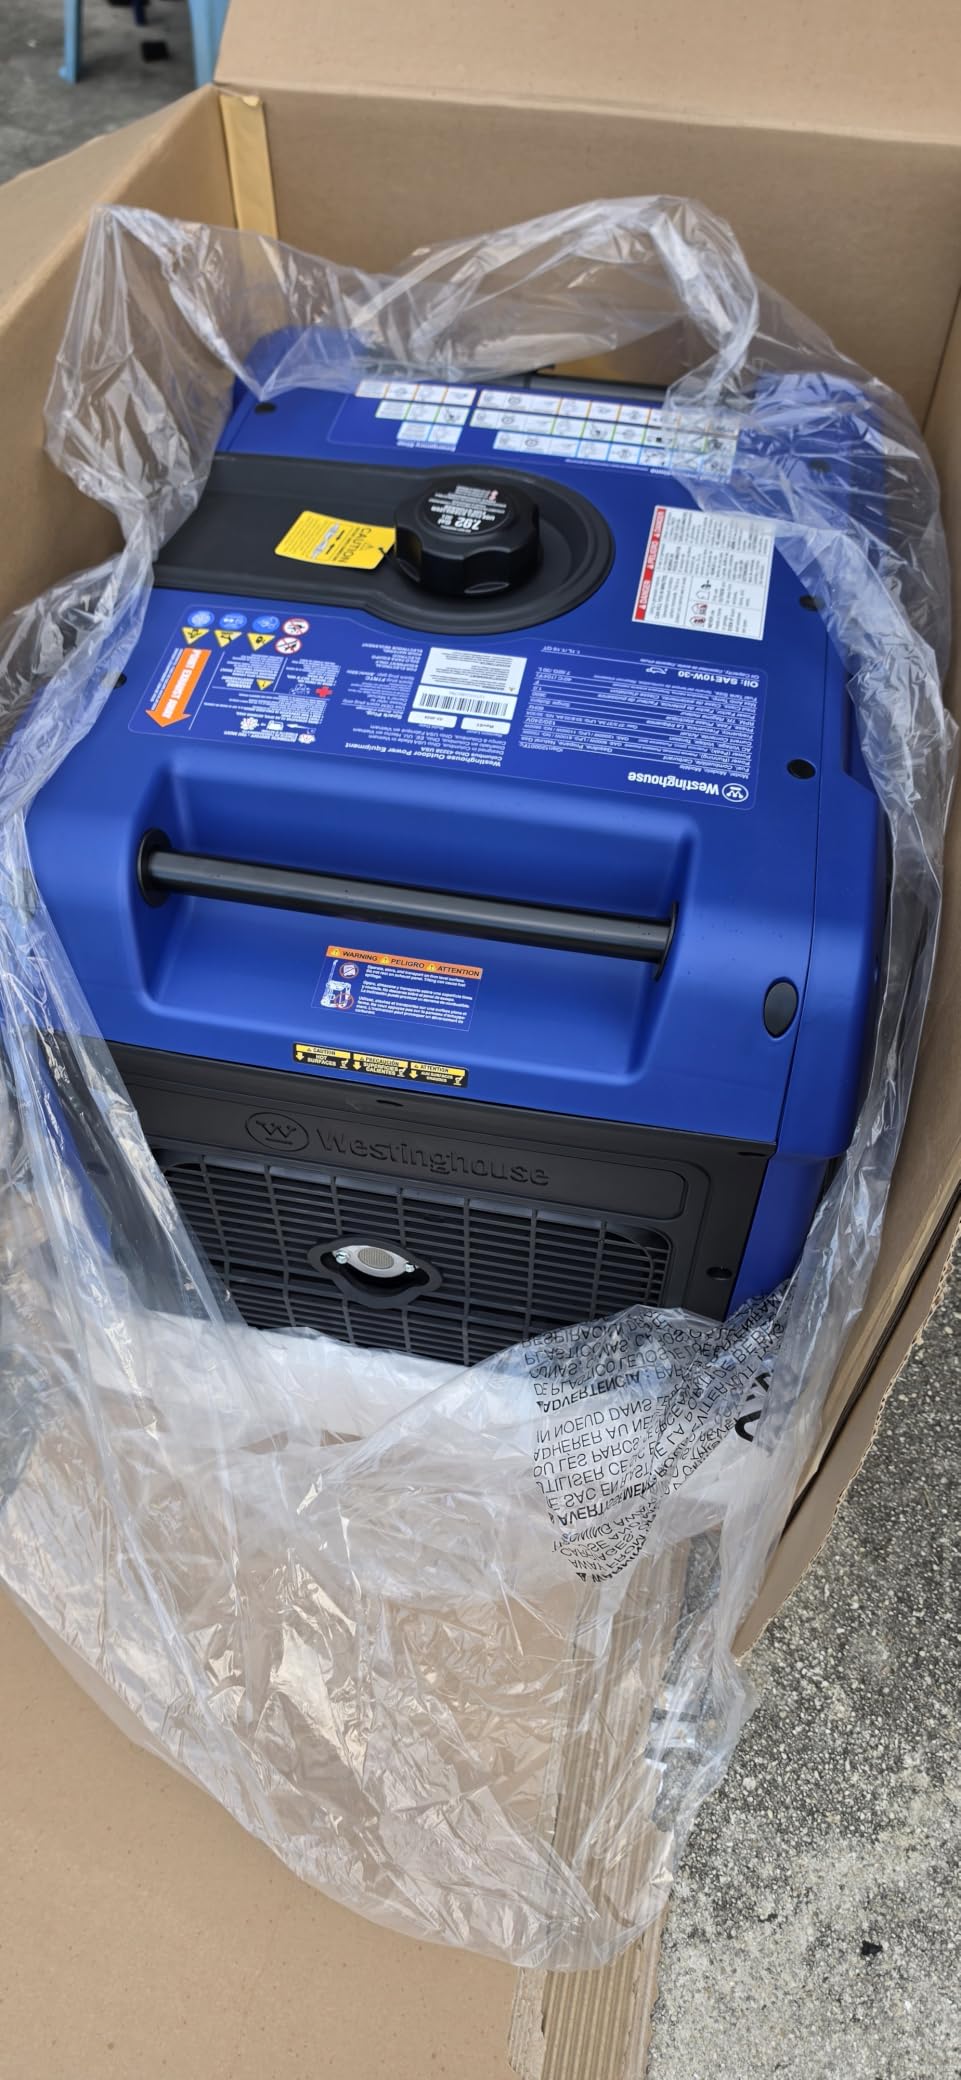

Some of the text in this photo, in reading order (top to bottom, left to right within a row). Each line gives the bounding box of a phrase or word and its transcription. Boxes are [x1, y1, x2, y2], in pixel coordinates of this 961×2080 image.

[338, 527, 372, 563] CAUTION
[677, 670, 737, 684] SAE10W-30
[740, 679, 758, 687] Oil:
[344, 741, 501, 766] Westinghouse Outdoor Power Equipment
[626, 769, 719, 794] Westinghouse
[342, 951, 479, 976] WARNING PELIGRO ATTENTION
[307, 1057, 336, 1065] SURFACES
[420, 1064, 448, 1072] ATTENTION
[316, 1128, 550, 1187] Westinghouse
